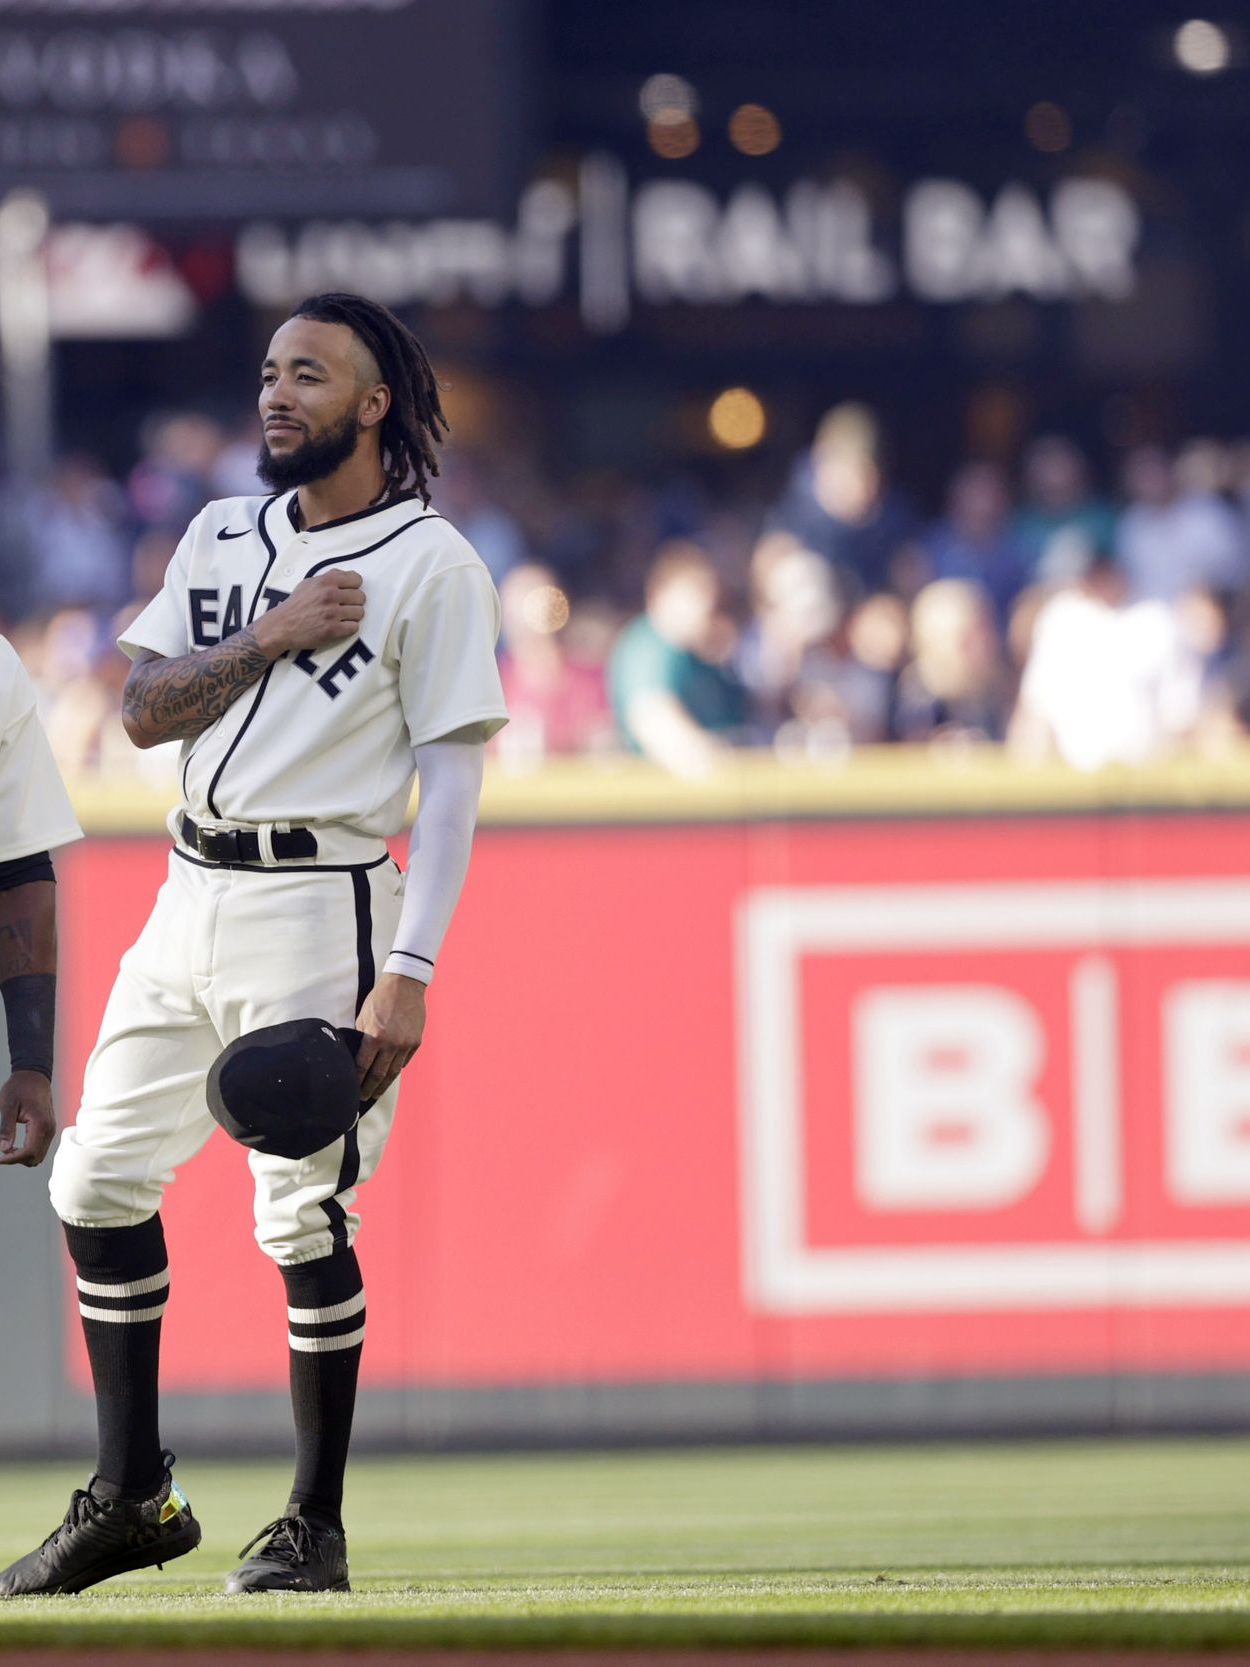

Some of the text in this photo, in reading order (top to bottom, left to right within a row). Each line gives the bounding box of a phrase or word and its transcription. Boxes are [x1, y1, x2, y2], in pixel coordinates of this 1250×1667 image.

[634, 178, 892, 302] RAIL
[903, 176, 1138, 302] BAR
[146, 656, 240, 726] Crawford
